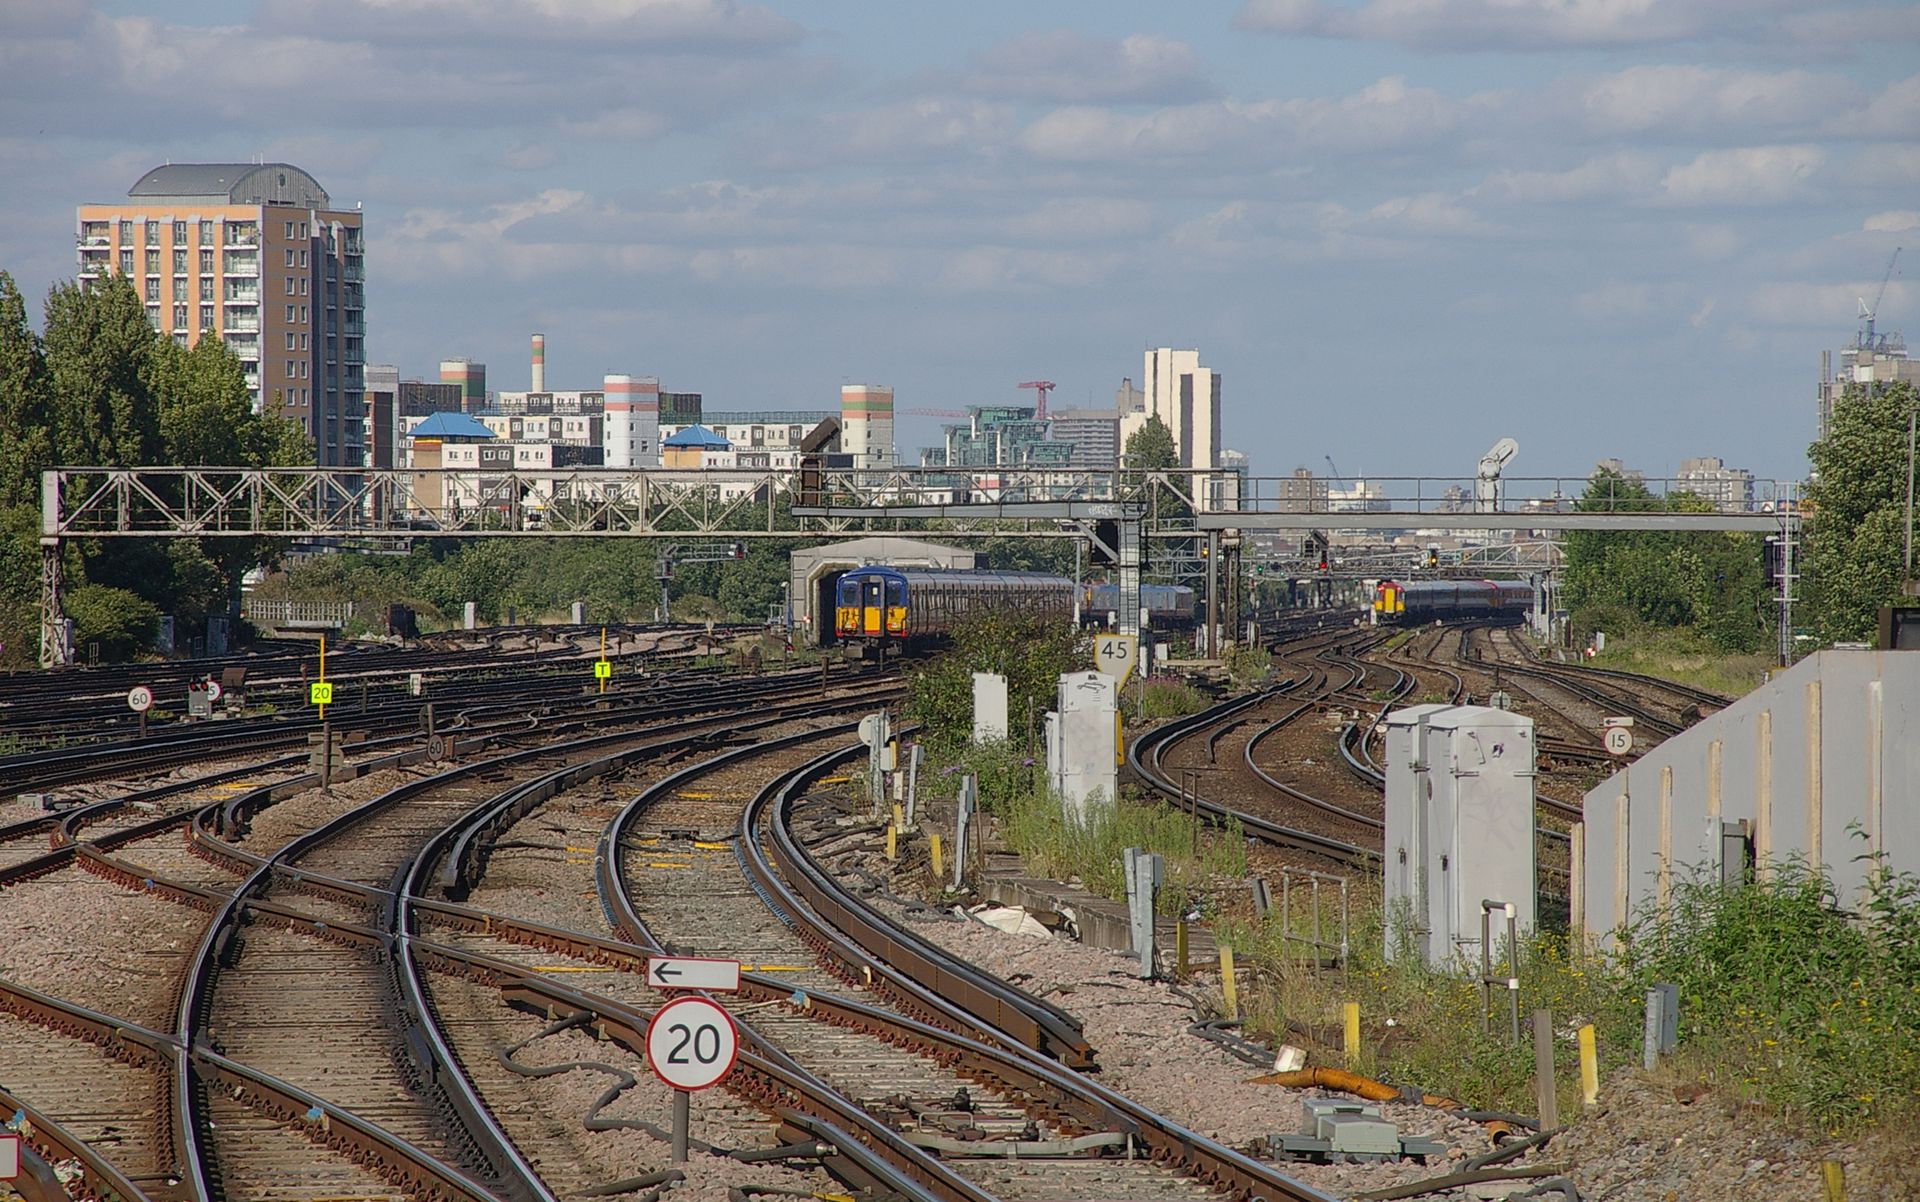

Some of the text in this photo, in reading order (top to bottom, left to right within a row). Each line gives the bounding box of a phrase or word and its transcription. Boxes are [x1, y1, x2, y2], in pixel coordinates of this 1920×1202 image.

[1101, 641, 1127, 659] 45
[598, 664, 608, 676] T
[132, 692, 148, 705] 60
[313, 687, 330, 700] 20
[1612, 733, 1626, 748] 15
[430, 741, 442, 754] 60
[667, 1023, 720, 1064] 20
